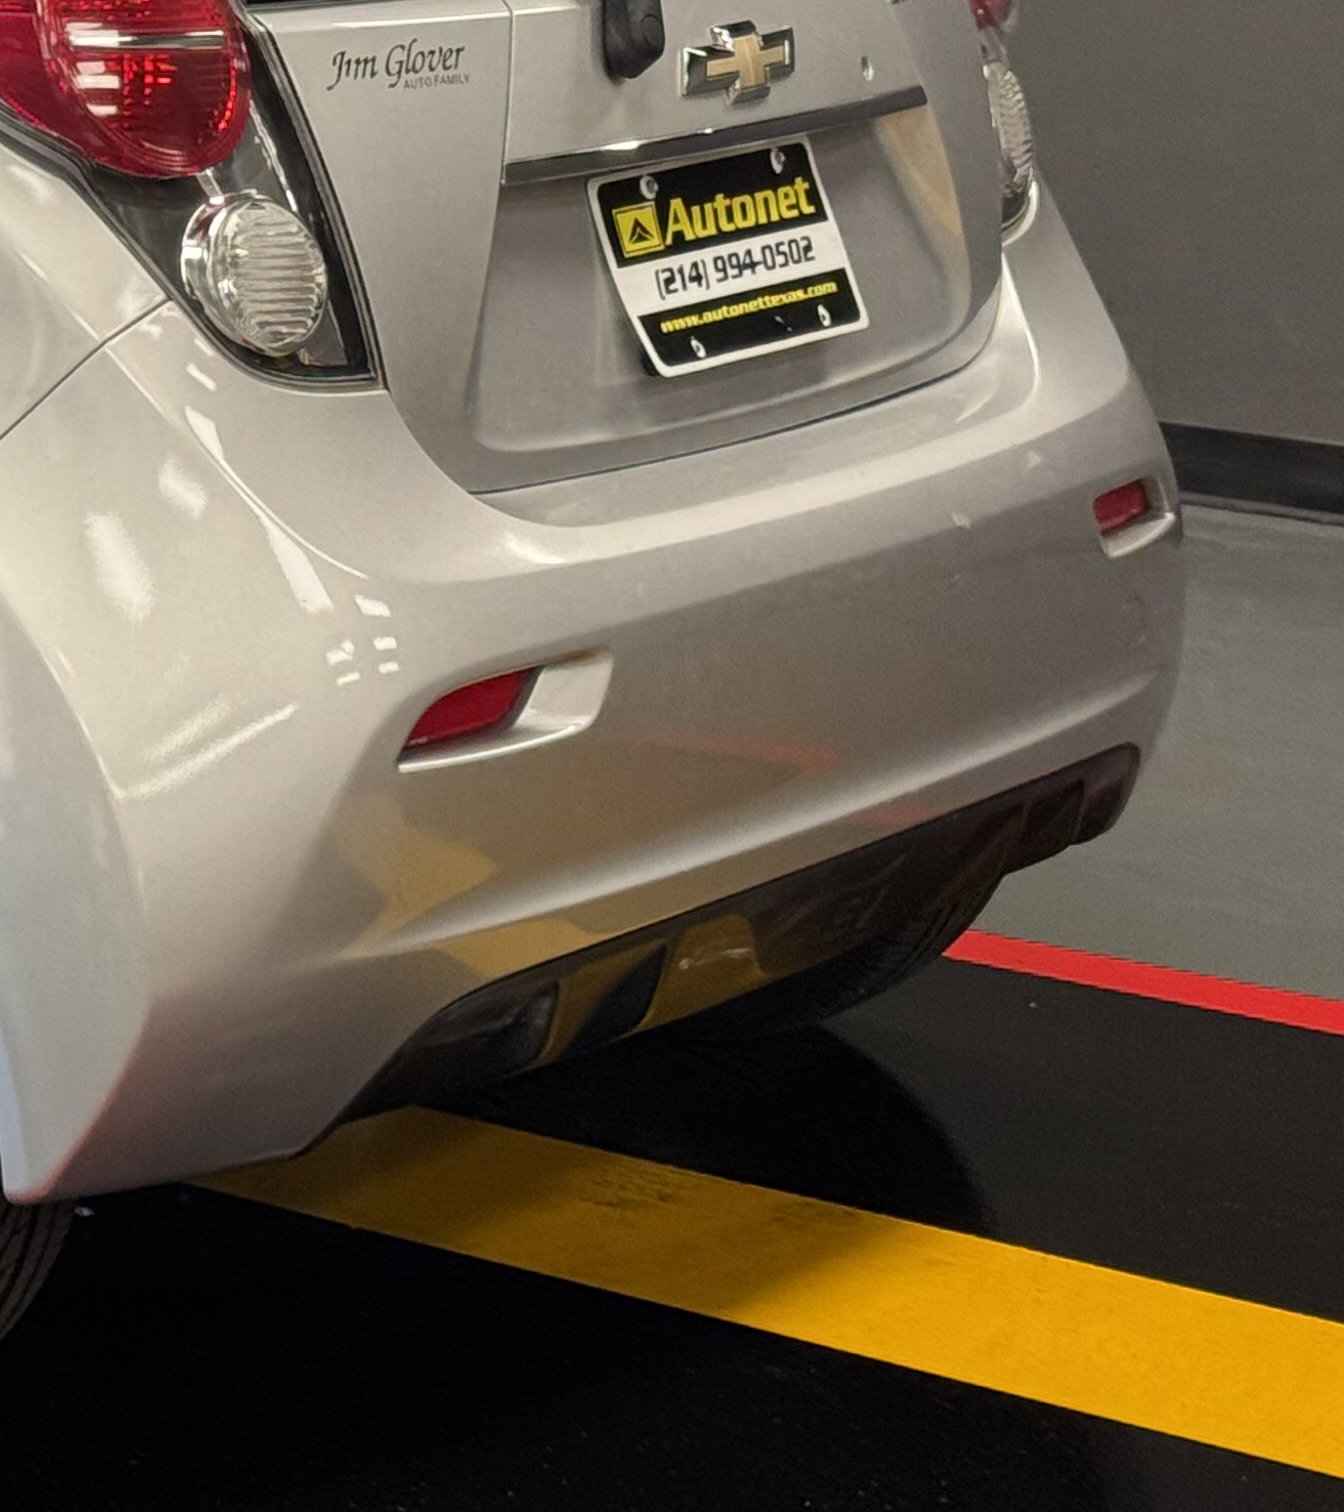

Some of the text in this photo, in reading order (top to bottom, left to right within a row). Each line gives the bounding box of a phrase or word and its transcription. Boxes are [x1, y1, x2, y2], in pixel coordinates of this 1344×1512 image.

[326, 38, 466, 91] Jim Glover
[403, 73, 470, 89] AUTO FAMILY
[664, 177, 816, 246] Autonet
[655, 235, 816, 300] (214) 994-0502
[660, 281, 838, 334] www.autonettexas.com
